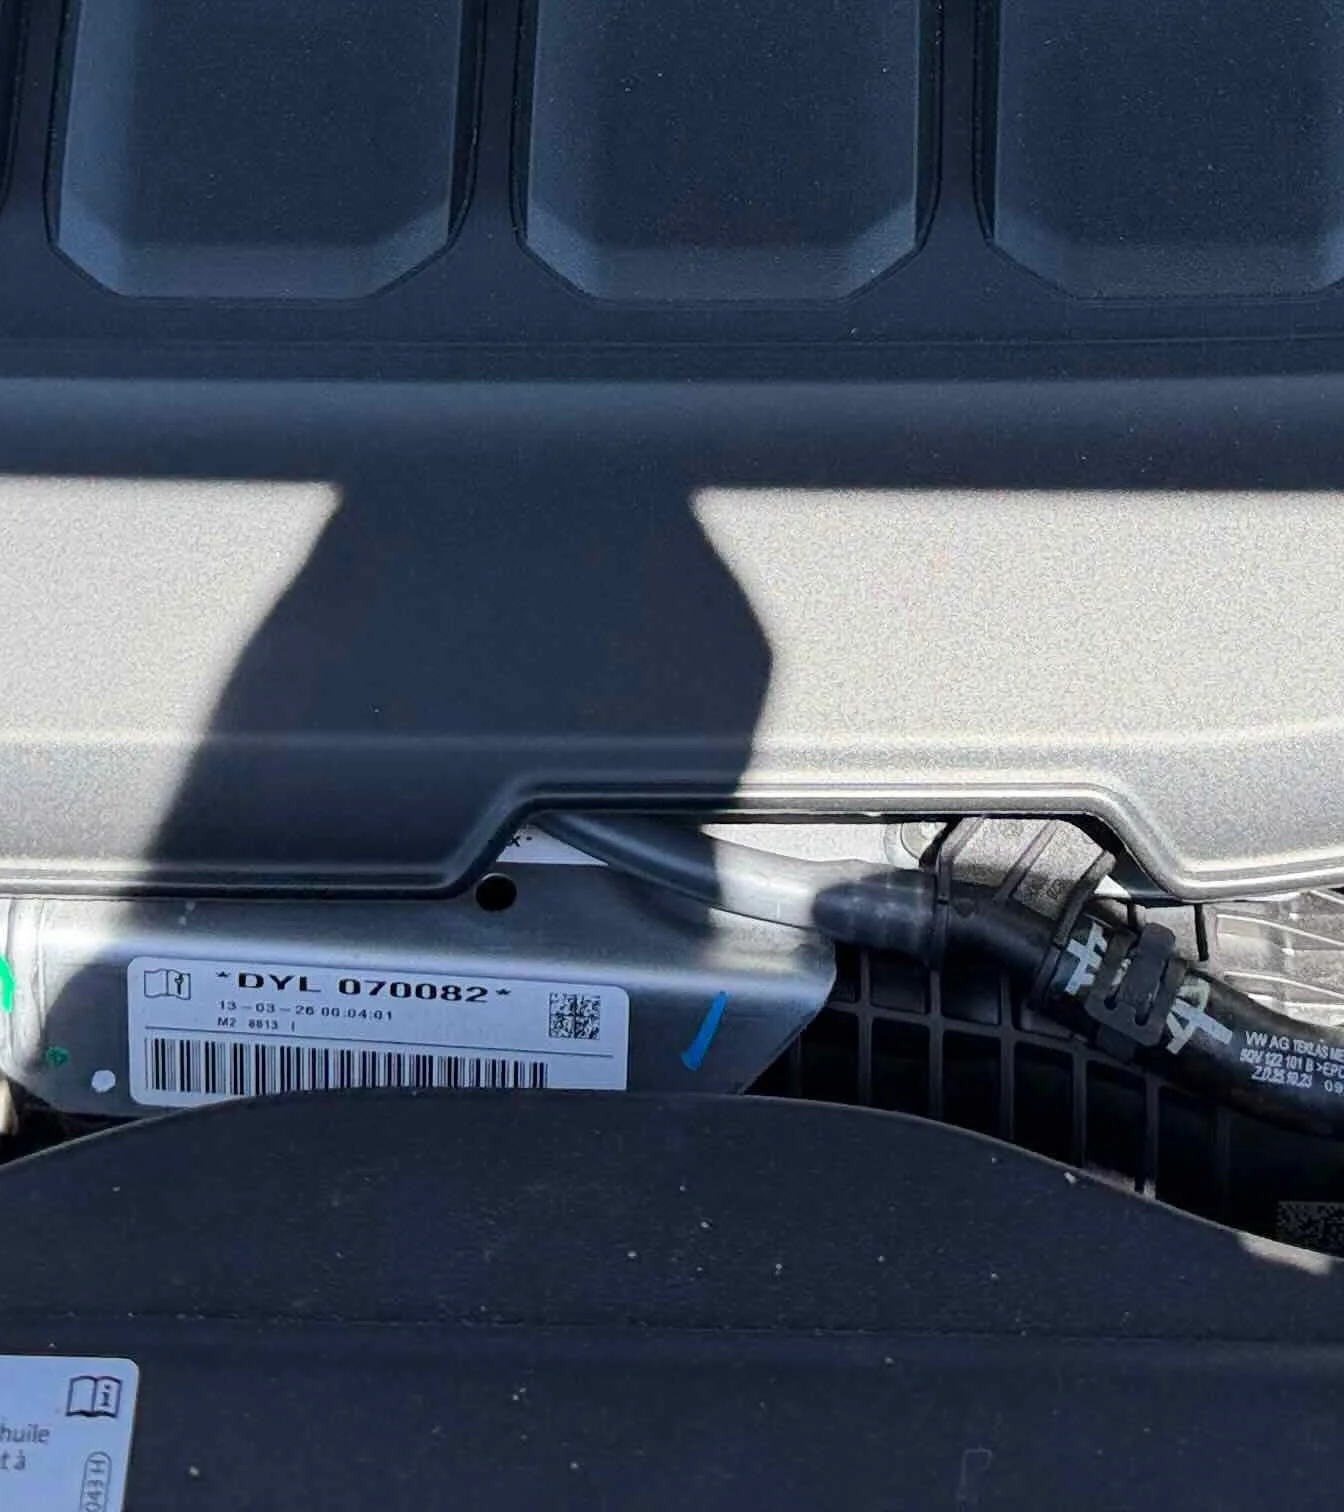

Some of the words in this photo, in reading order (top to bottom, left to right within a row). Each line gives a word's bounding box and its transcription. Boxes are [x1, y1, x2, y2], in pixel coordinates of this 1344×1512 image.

[217, 1016, 238, 1029] M2
[1244, 1031, 1269, 1048] VW
[1269, 1035, 1291, 1051] AG
[12, 1450, 28, 1472] à
